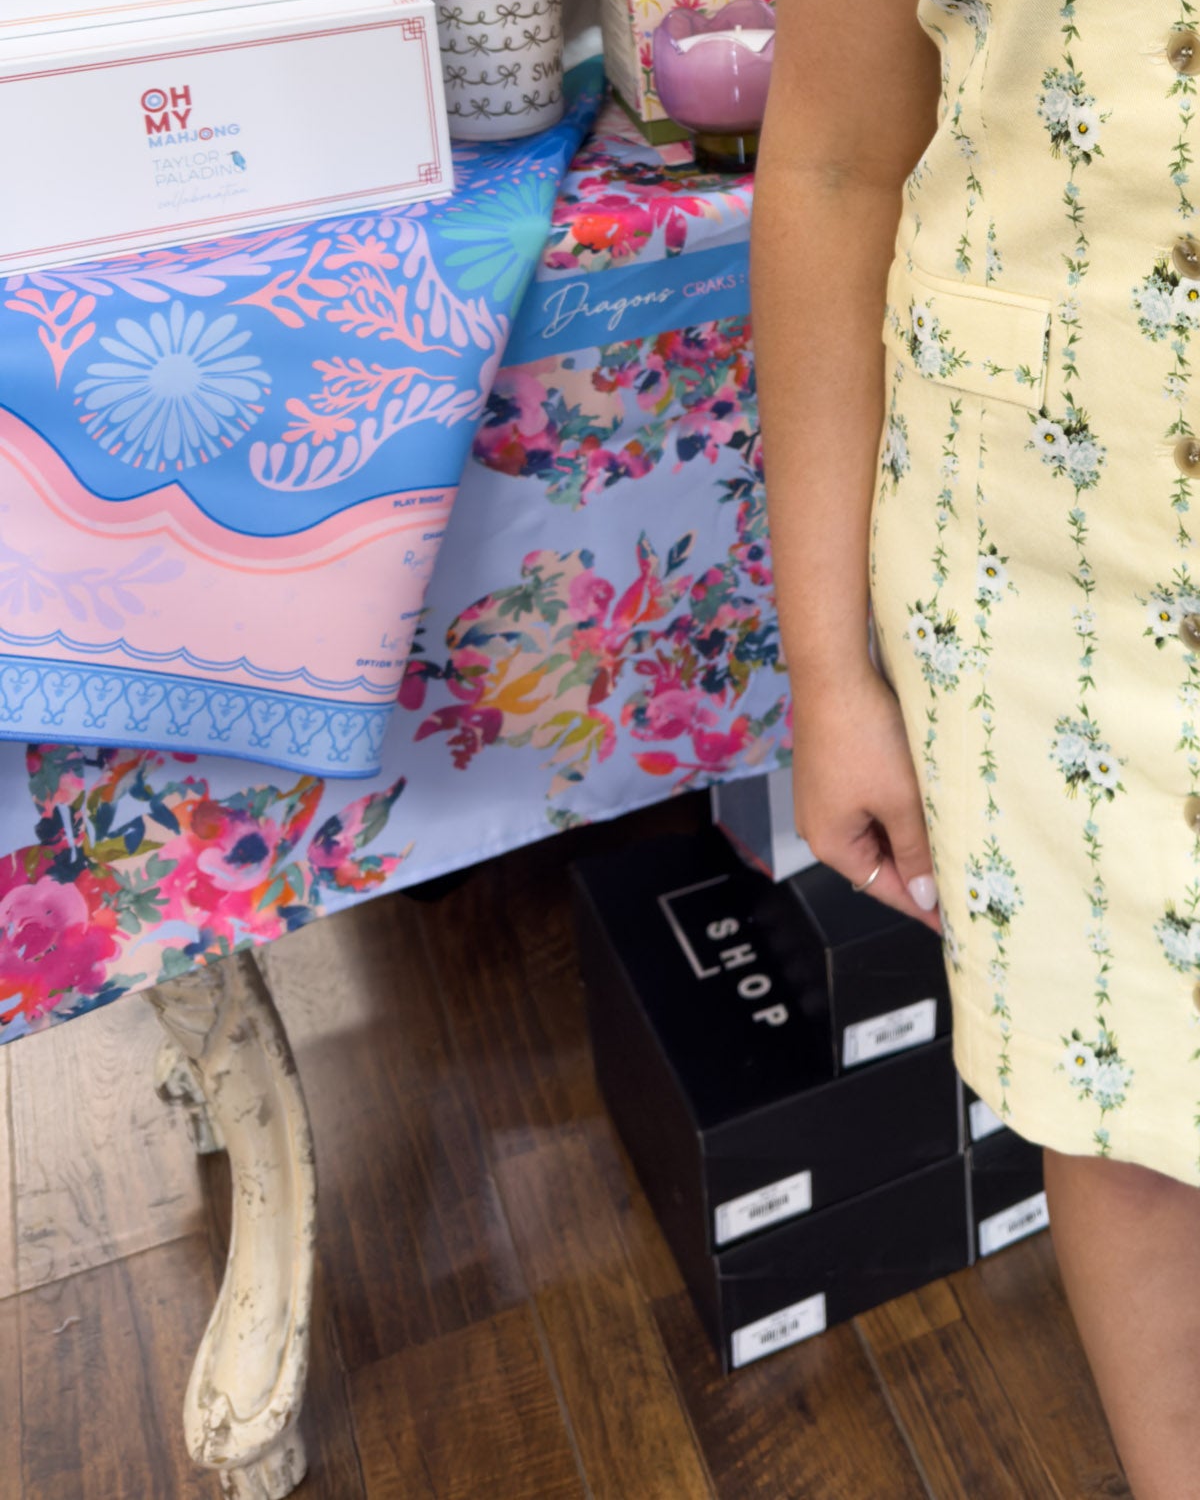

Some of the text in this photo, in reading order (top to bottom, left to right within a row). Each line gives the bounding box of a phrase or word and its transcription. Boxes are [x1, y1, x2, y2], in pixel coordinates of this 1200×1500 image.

[140, 85, 192, 113] OH
[144, 108, 192, 135] MY
[148, 123, 241, 148] MAHJONG
[152, 150, 219, 172] TAYLOR
[542, 282, 674, 338] Dragons
[705, 916, 789, 1027] SHOP
